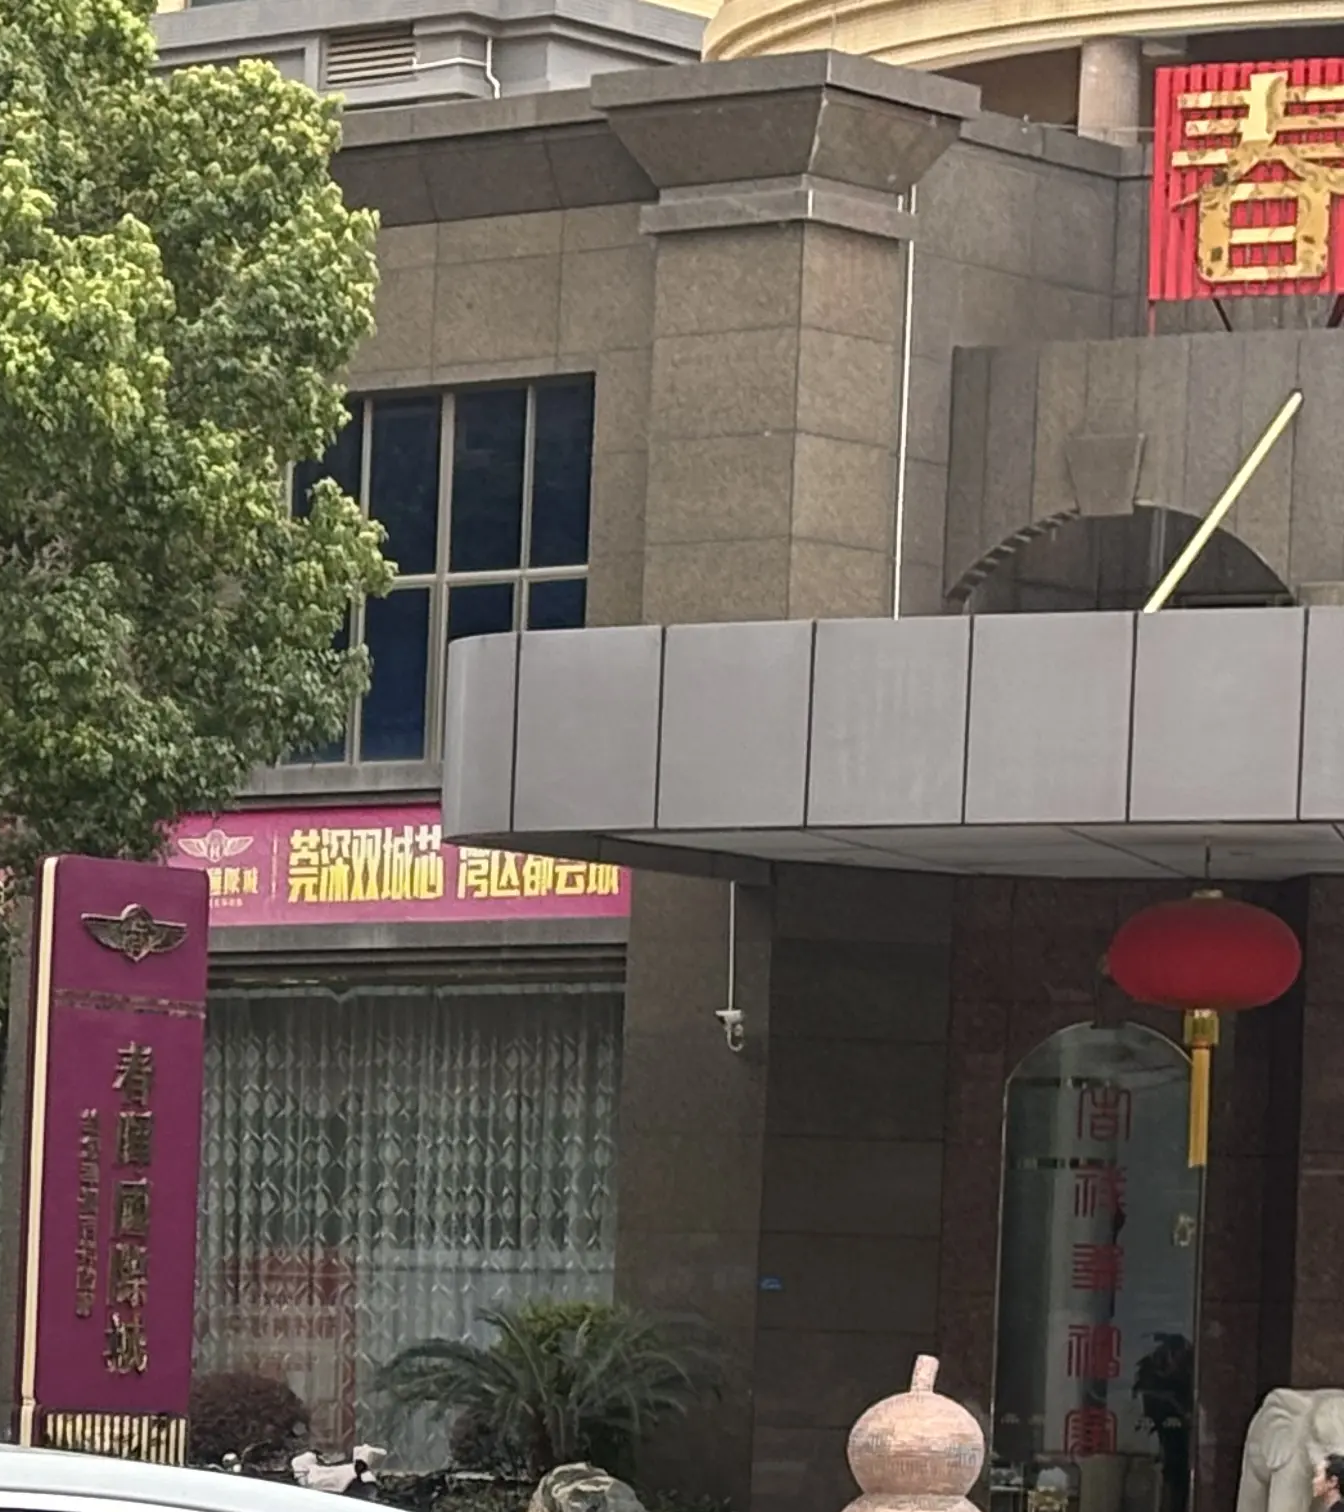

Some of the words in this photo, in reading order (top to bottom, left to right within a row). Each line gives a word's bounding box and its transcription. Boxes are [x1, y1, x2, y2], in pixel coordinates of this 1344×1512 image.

[1171, 70, 1344, 283] 春
[288, 824, 443, 904] 莞深双城芯
